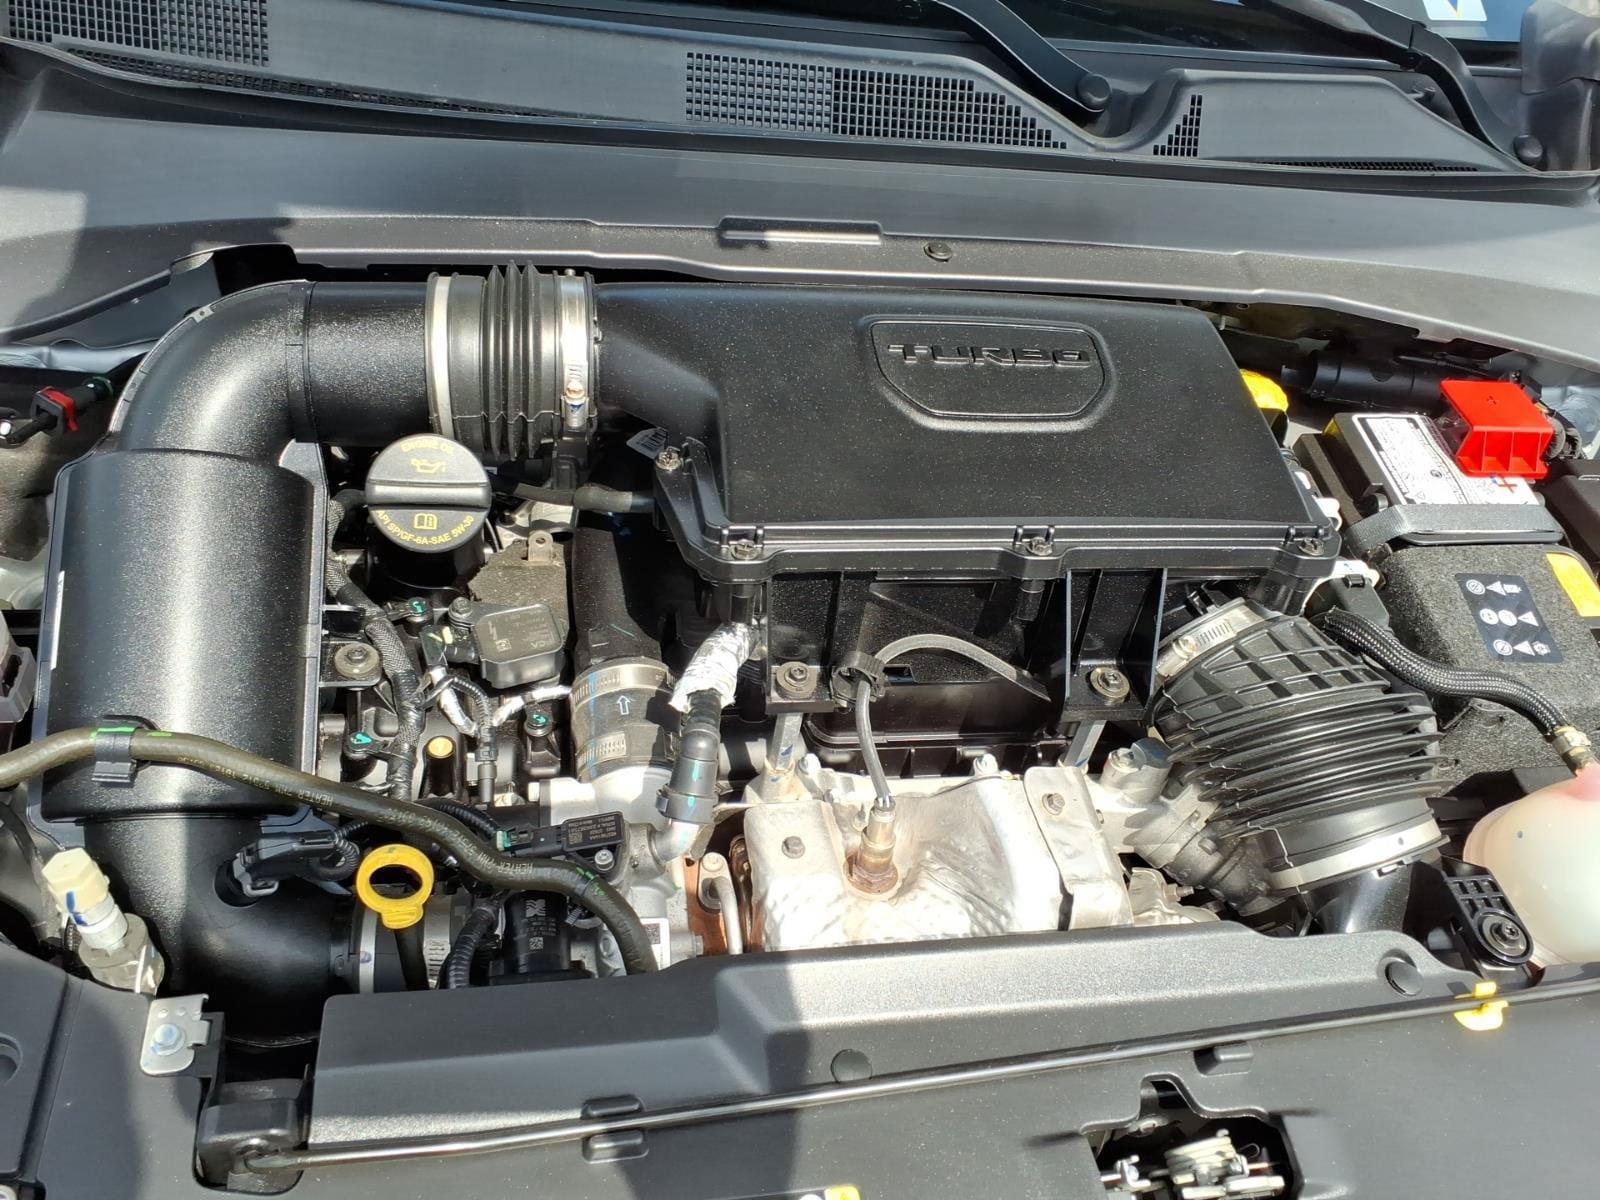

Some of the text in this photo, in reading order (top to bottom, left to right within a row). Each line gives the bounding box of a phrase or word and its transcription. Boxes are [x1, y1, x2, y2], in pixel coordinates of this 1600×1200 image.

[887, 344, 1091, 367] TURBO
[376, 510, 391, 525] API
[451, 515, 475, 538] 5W-30
